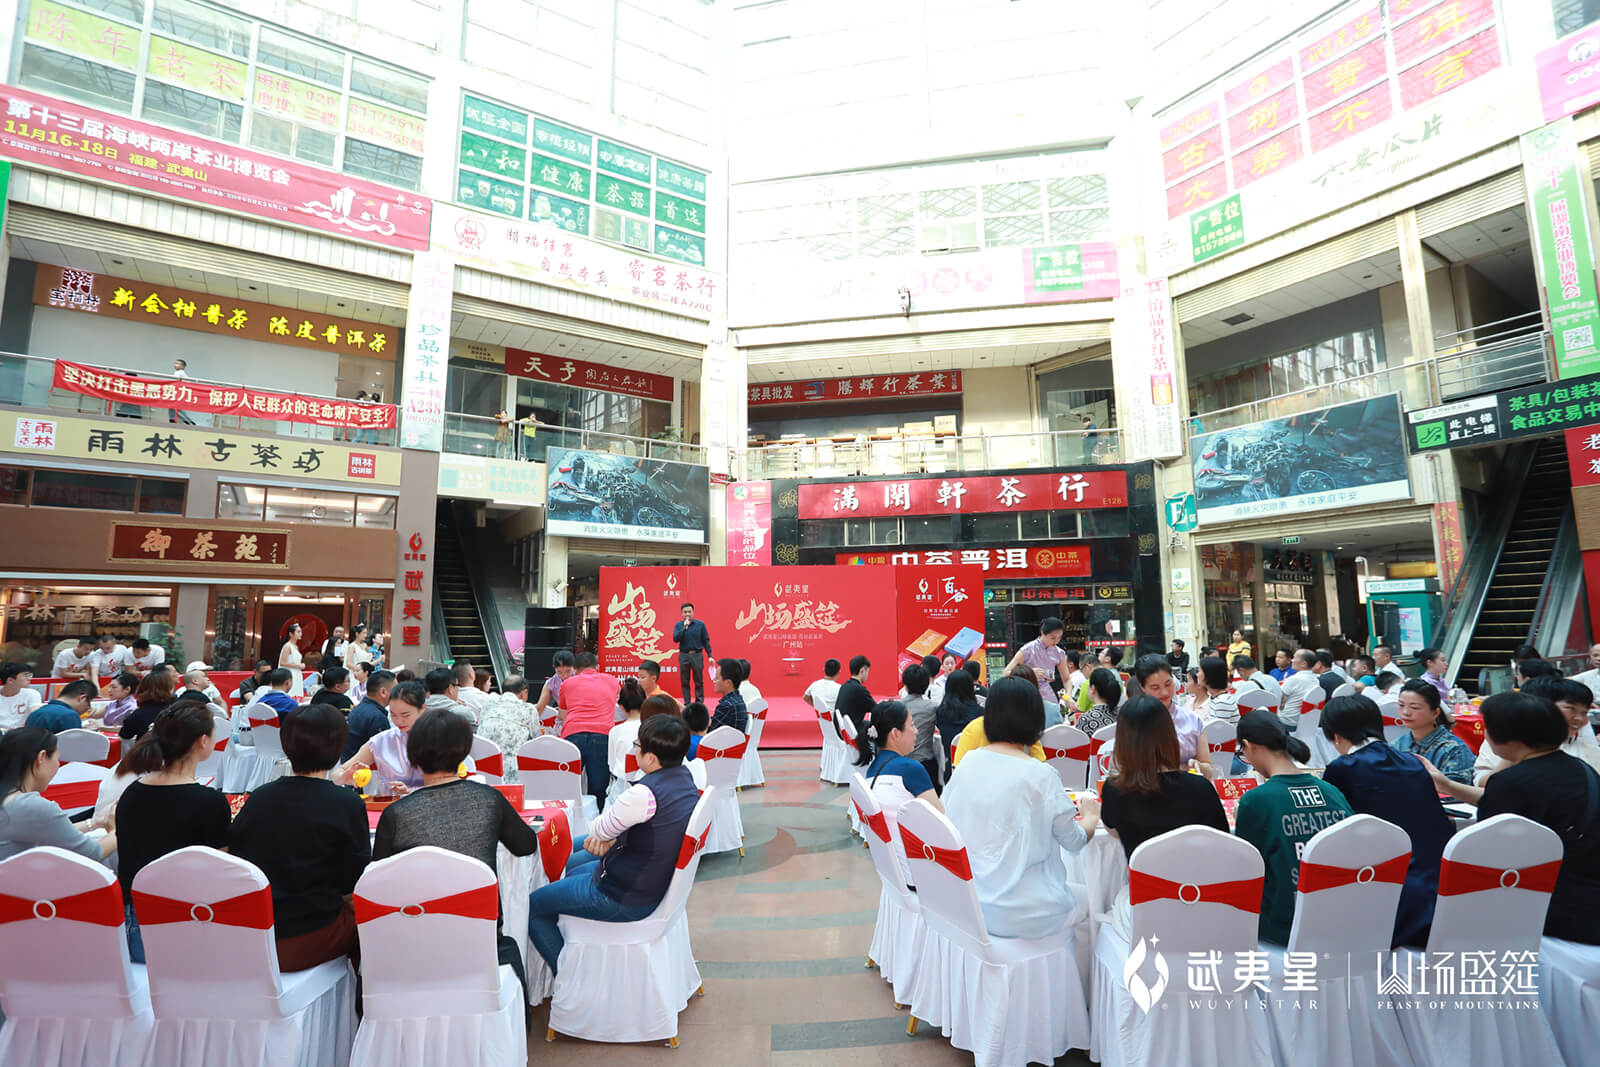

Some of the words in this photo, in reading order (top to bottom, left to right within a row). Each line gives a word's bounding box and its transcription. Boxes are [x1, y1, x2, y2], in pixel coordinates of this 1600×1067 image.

[5, 119, 119, 160] 11月16-18日
[7, 99, 291, 187] 第十三届海峡两岸茶业博览会
[1193, 201, 1241, 234] 广告位
[109, 287, 250, 331] 新会柑普茶
[269, 316, 387, 353] 陈皮普洱茶
[748, 385, 793, 400] 茶具批发
[1449, 412, 1494, 430] 此电梯
[88, 428, 325, 473] 雨林古茶坊
[401, 569, 425, 646] 武夷星
[1291, 788, 1324, 806] THE
